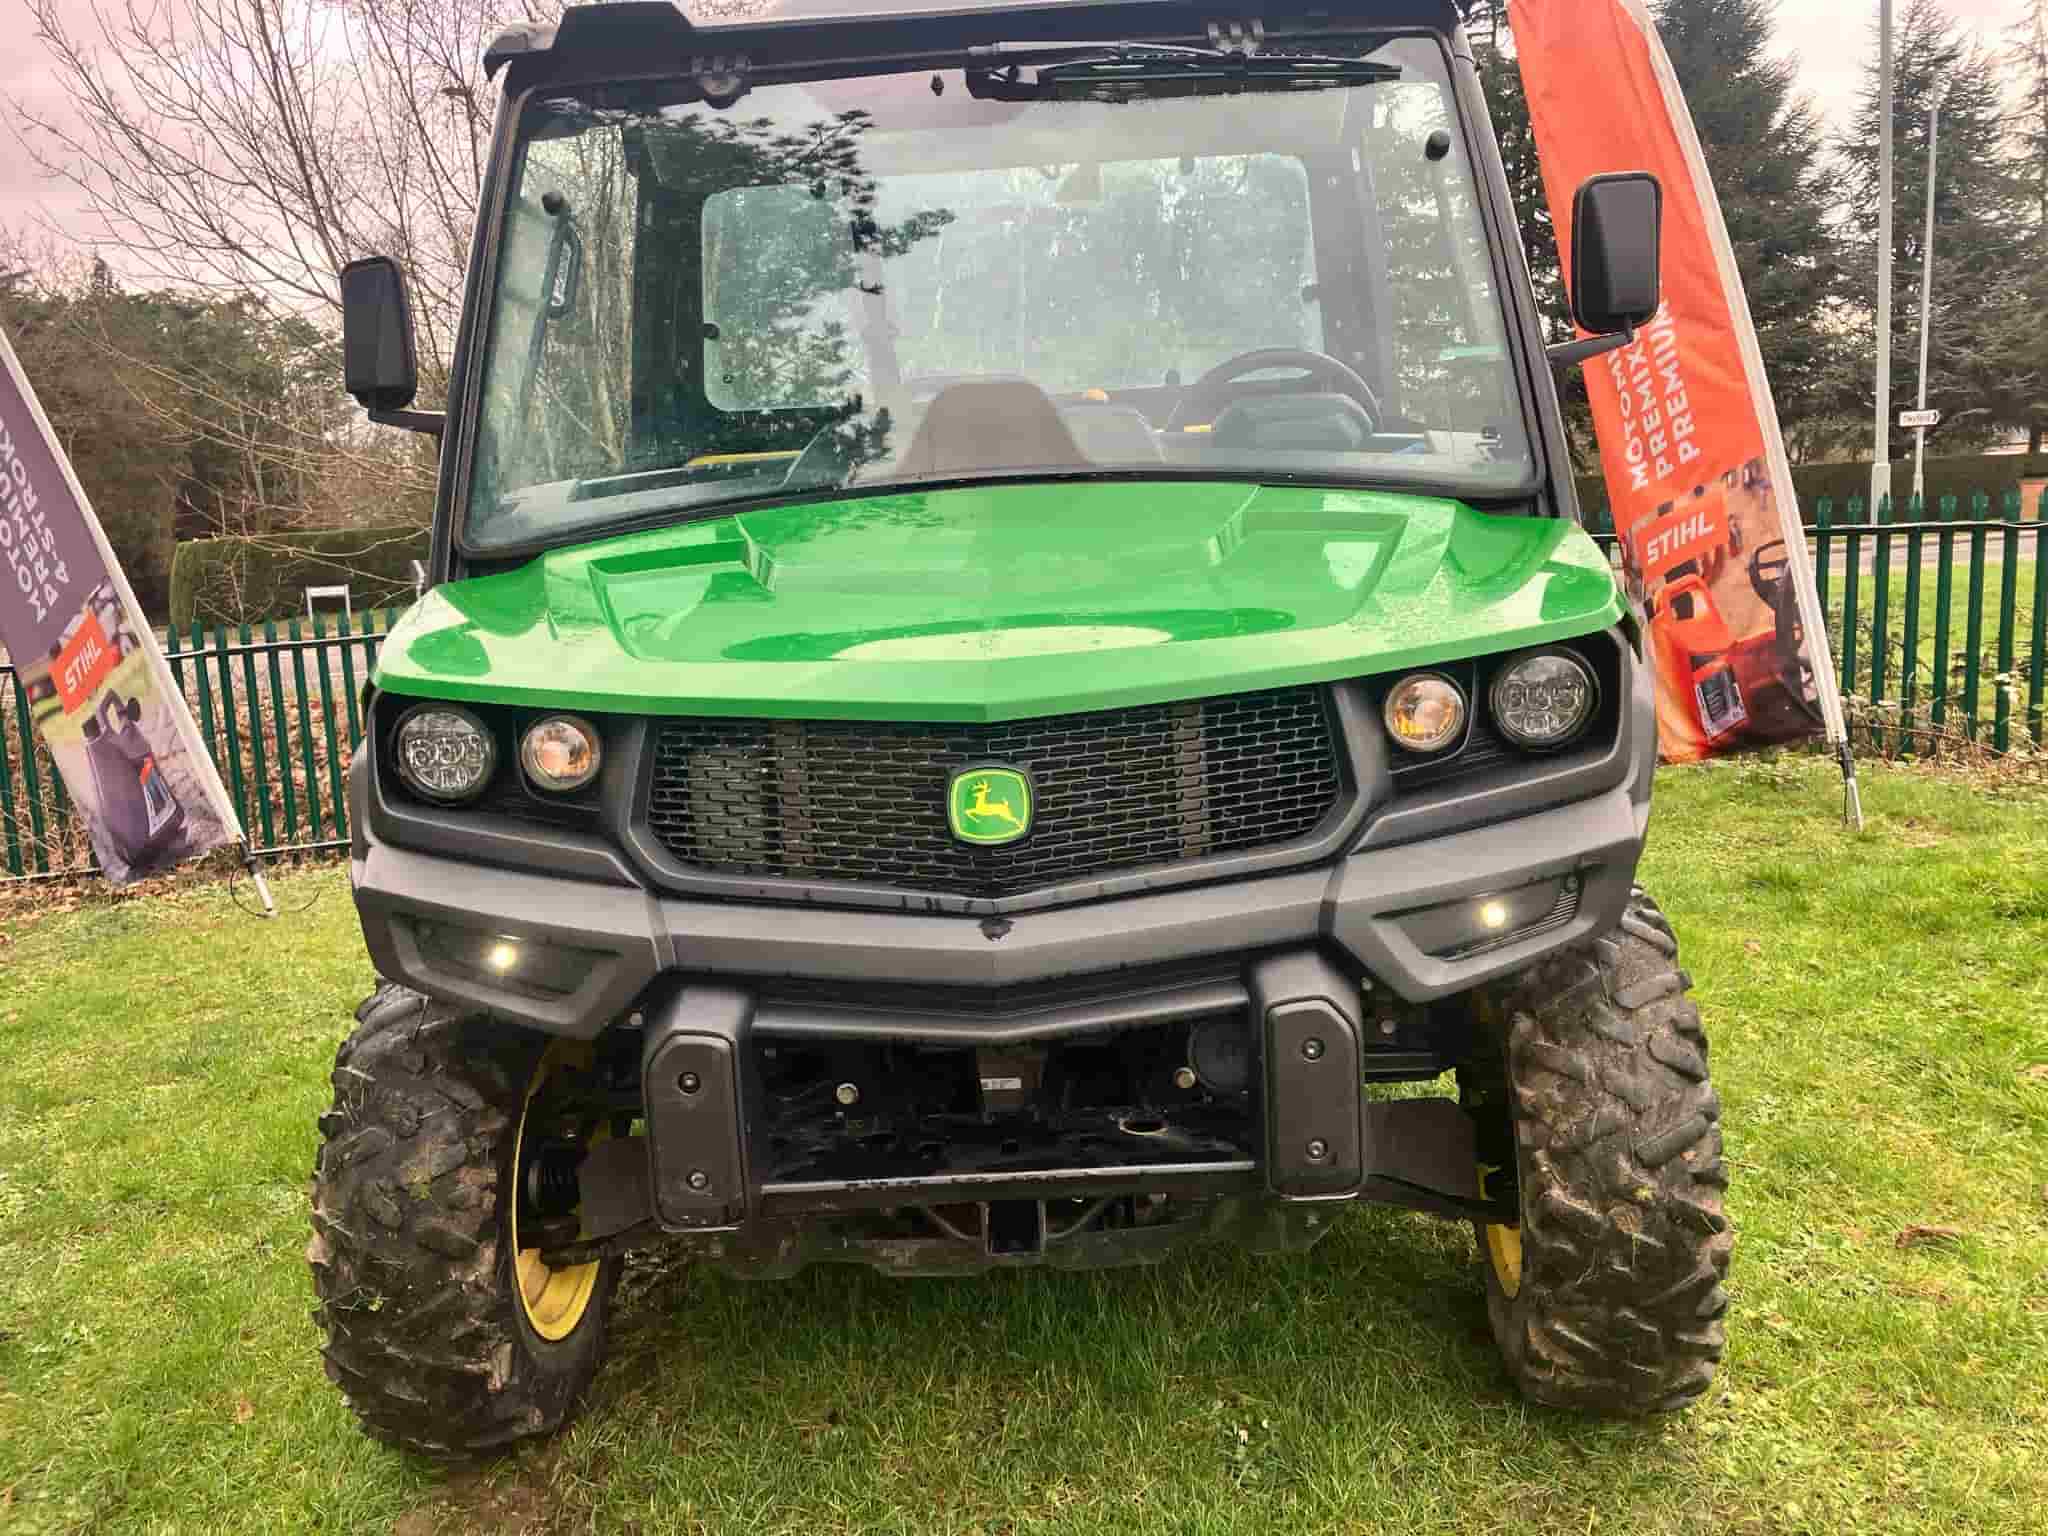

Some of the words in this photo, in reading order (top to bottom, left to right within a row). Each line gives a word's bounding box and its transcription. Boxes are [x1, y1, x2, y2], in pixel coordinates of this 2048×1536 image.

[0, 471, 59, 607] PREMIU
[0, 514, 46, 624] MOTO
[1647, 512, 1714, 566] STIHL
[64, 636, 102, 694] STIHL
